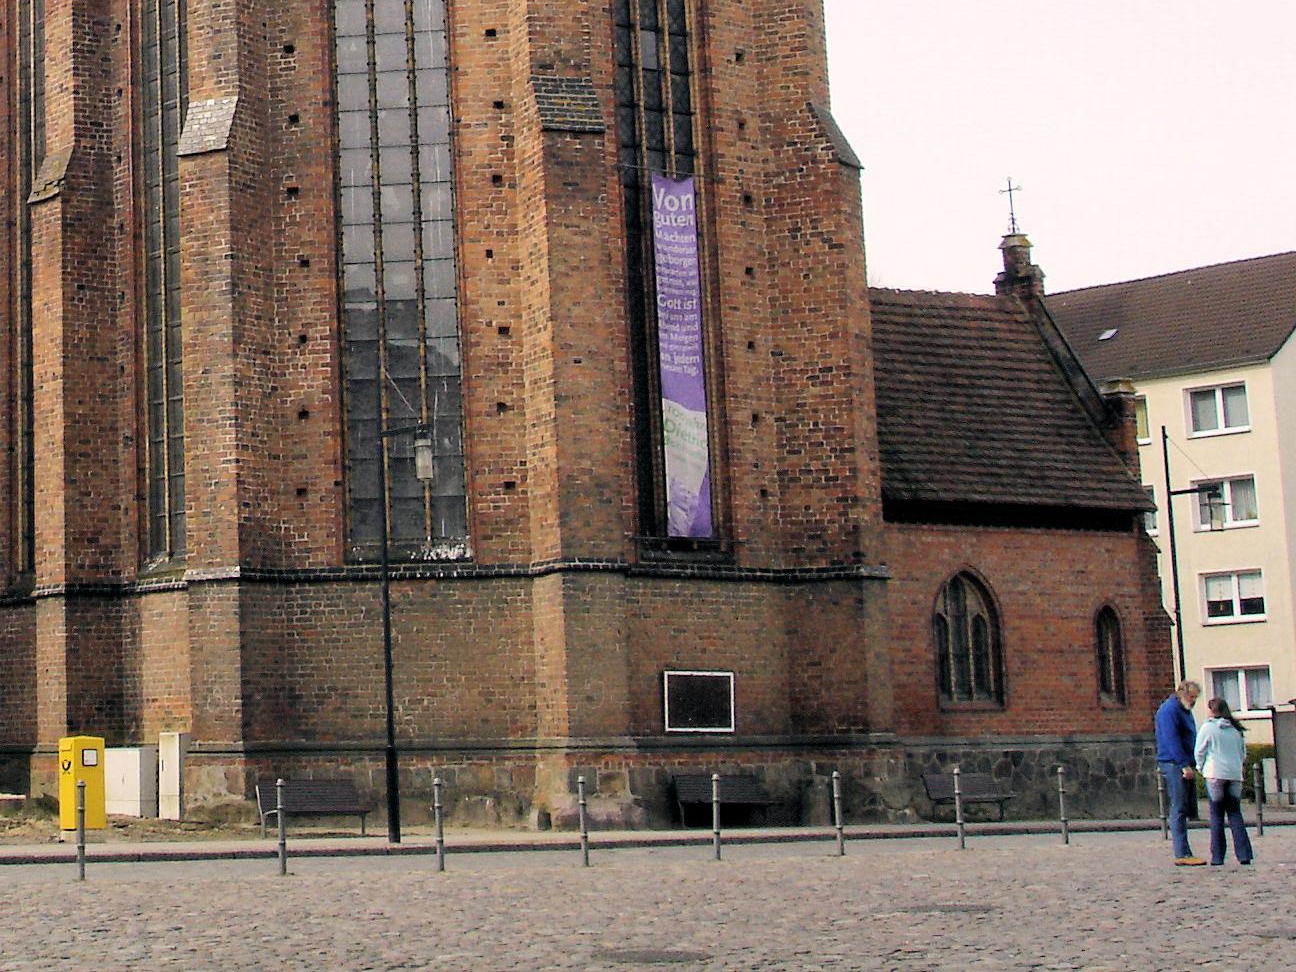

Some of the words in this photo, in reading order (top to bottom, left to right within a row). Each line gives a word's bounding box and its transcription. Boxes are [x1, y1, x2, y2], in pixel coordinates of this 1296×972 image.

[652, 183, 693, 212] Von
[653, 211, 694, 228] guten
[657, 294, 682, 310] Gott
[683, 297, 696, 310] ist
